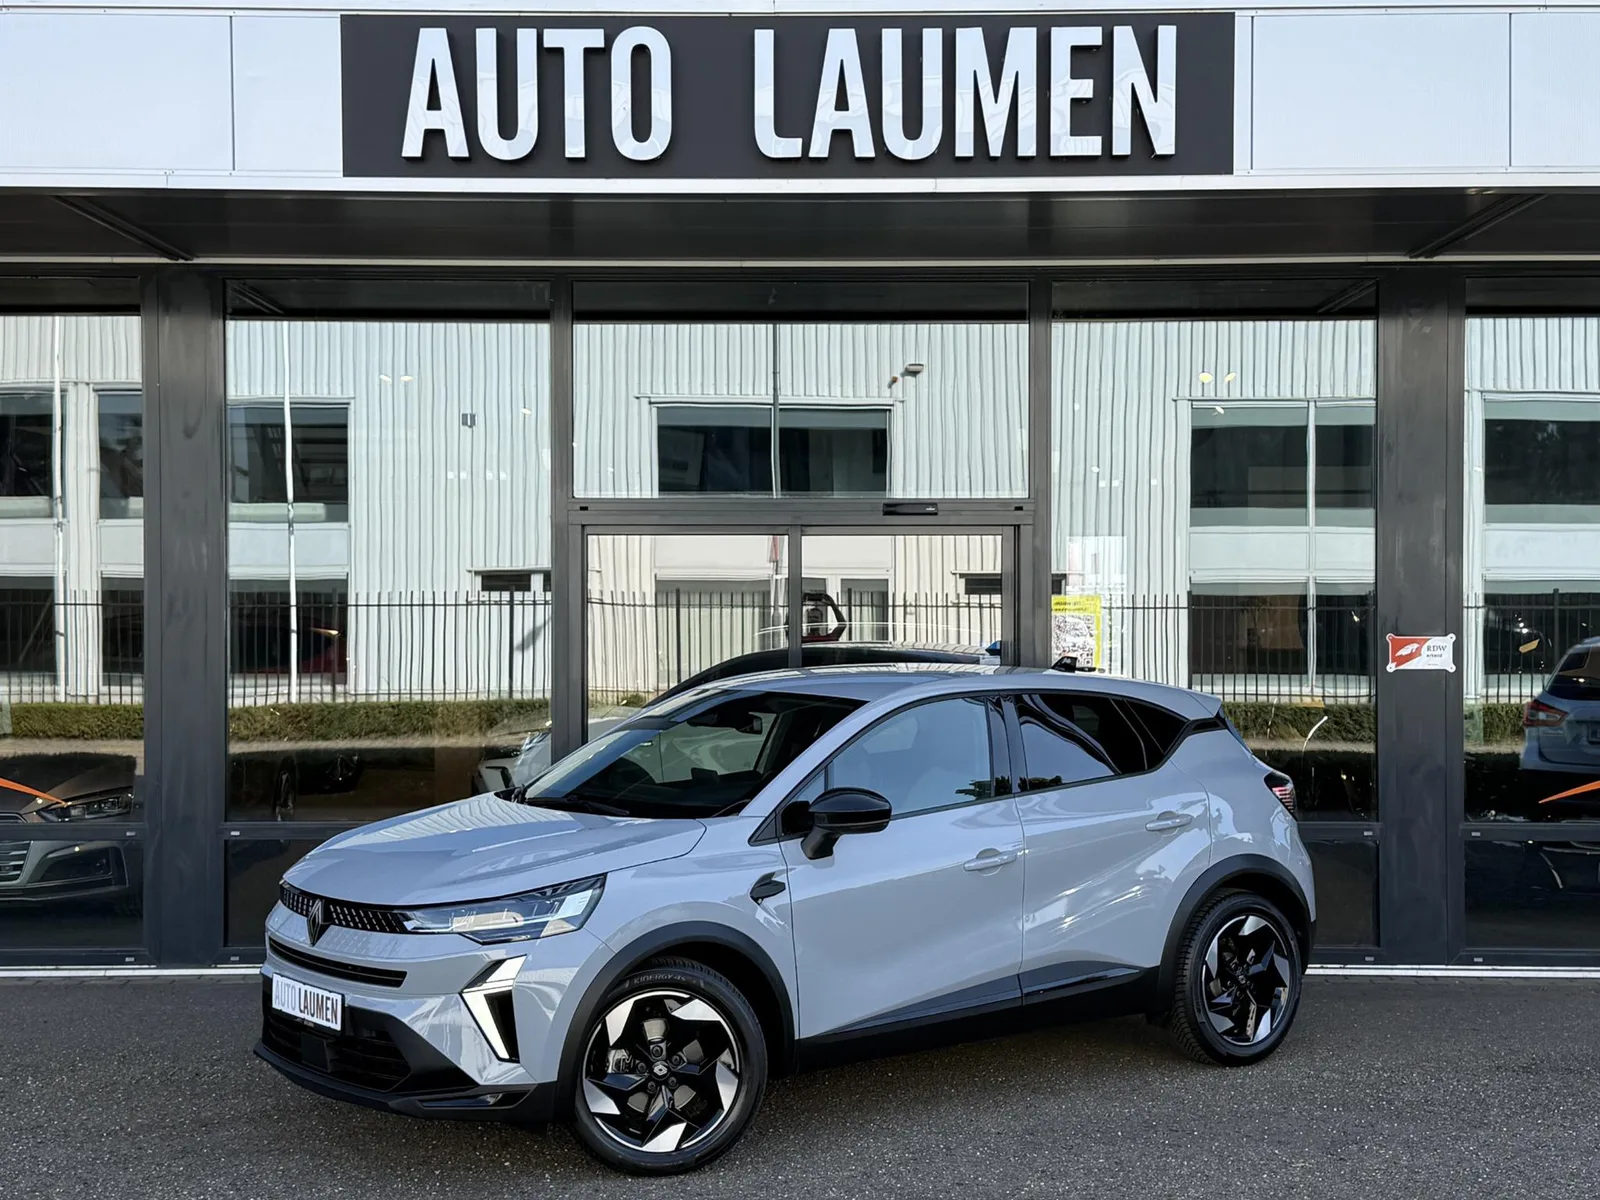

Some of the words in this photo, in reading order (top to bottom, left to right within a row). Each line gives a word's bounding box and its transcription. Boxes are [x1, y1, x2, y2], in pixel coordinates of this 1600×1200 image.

[401, 26, 672, 161] AUTO
[754, 25, 1177, 160] LAUMEN
[274, 980, 297, 1011] AUTO
[298, 987, 338, 1025] LAUMEN
